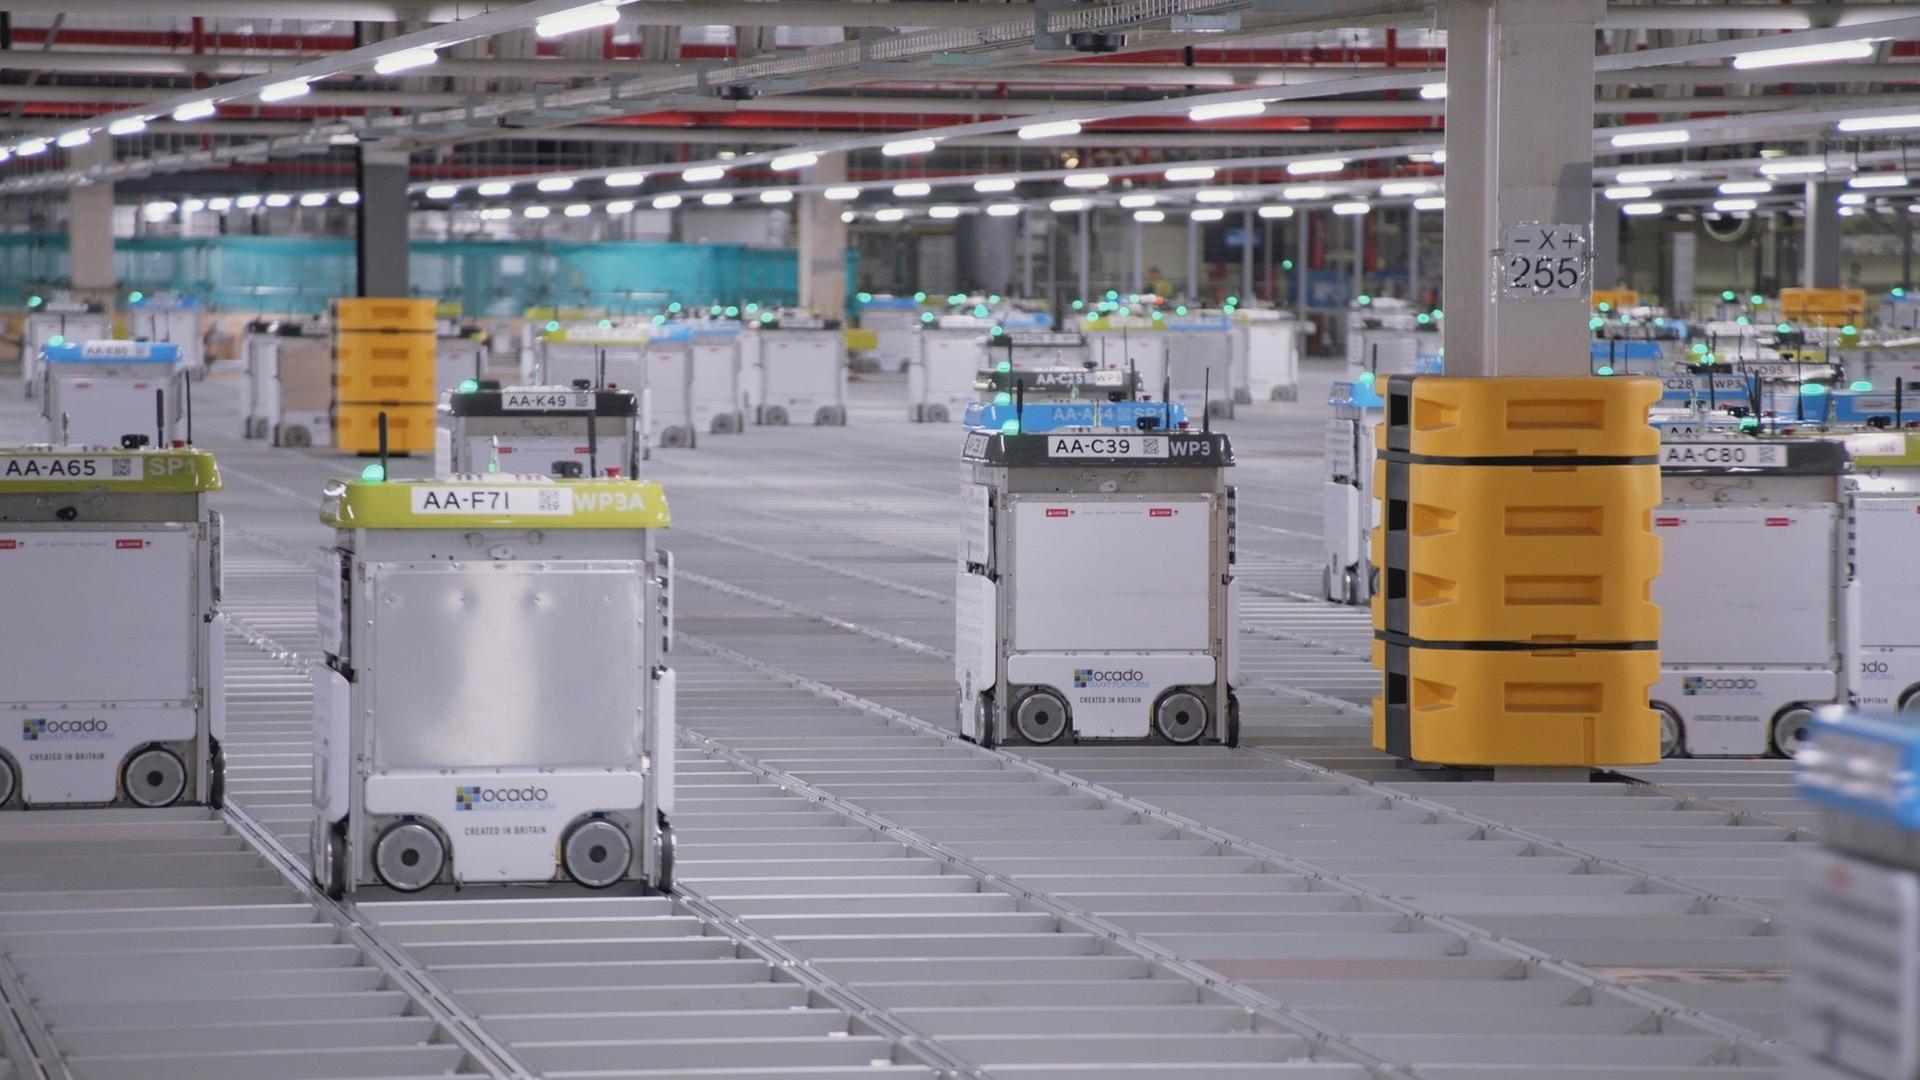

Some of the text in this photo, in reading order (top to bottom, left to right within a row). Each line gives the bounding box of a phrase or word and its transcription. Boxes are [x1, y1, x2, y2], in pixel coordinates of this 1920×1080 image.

[1510, 256, 1578, 288] 255
[1714, 379, 1743, 390] WP3
[508, 394, 567, 407] AA-K49
[1054, 439, 1211, 456] AA-C39 WP3
[1666, 447, 1747, 463] AA-C80
[5, 457, 197, 477] AA-A65 SP1
[574, 491, 646, 513] WP3A
[1093, 668, 1144, 681] ocado
[1703, 676, 1758, 690] ocado
[47, 718, 108, 733] ocado
[29, 753, 62, 761] CREATED
[75, 752, 105, 760] BRITAIN
[482, 786, 549, 802] ocado
[464, 825, 548, 836] CREATED IN BRITAIN
